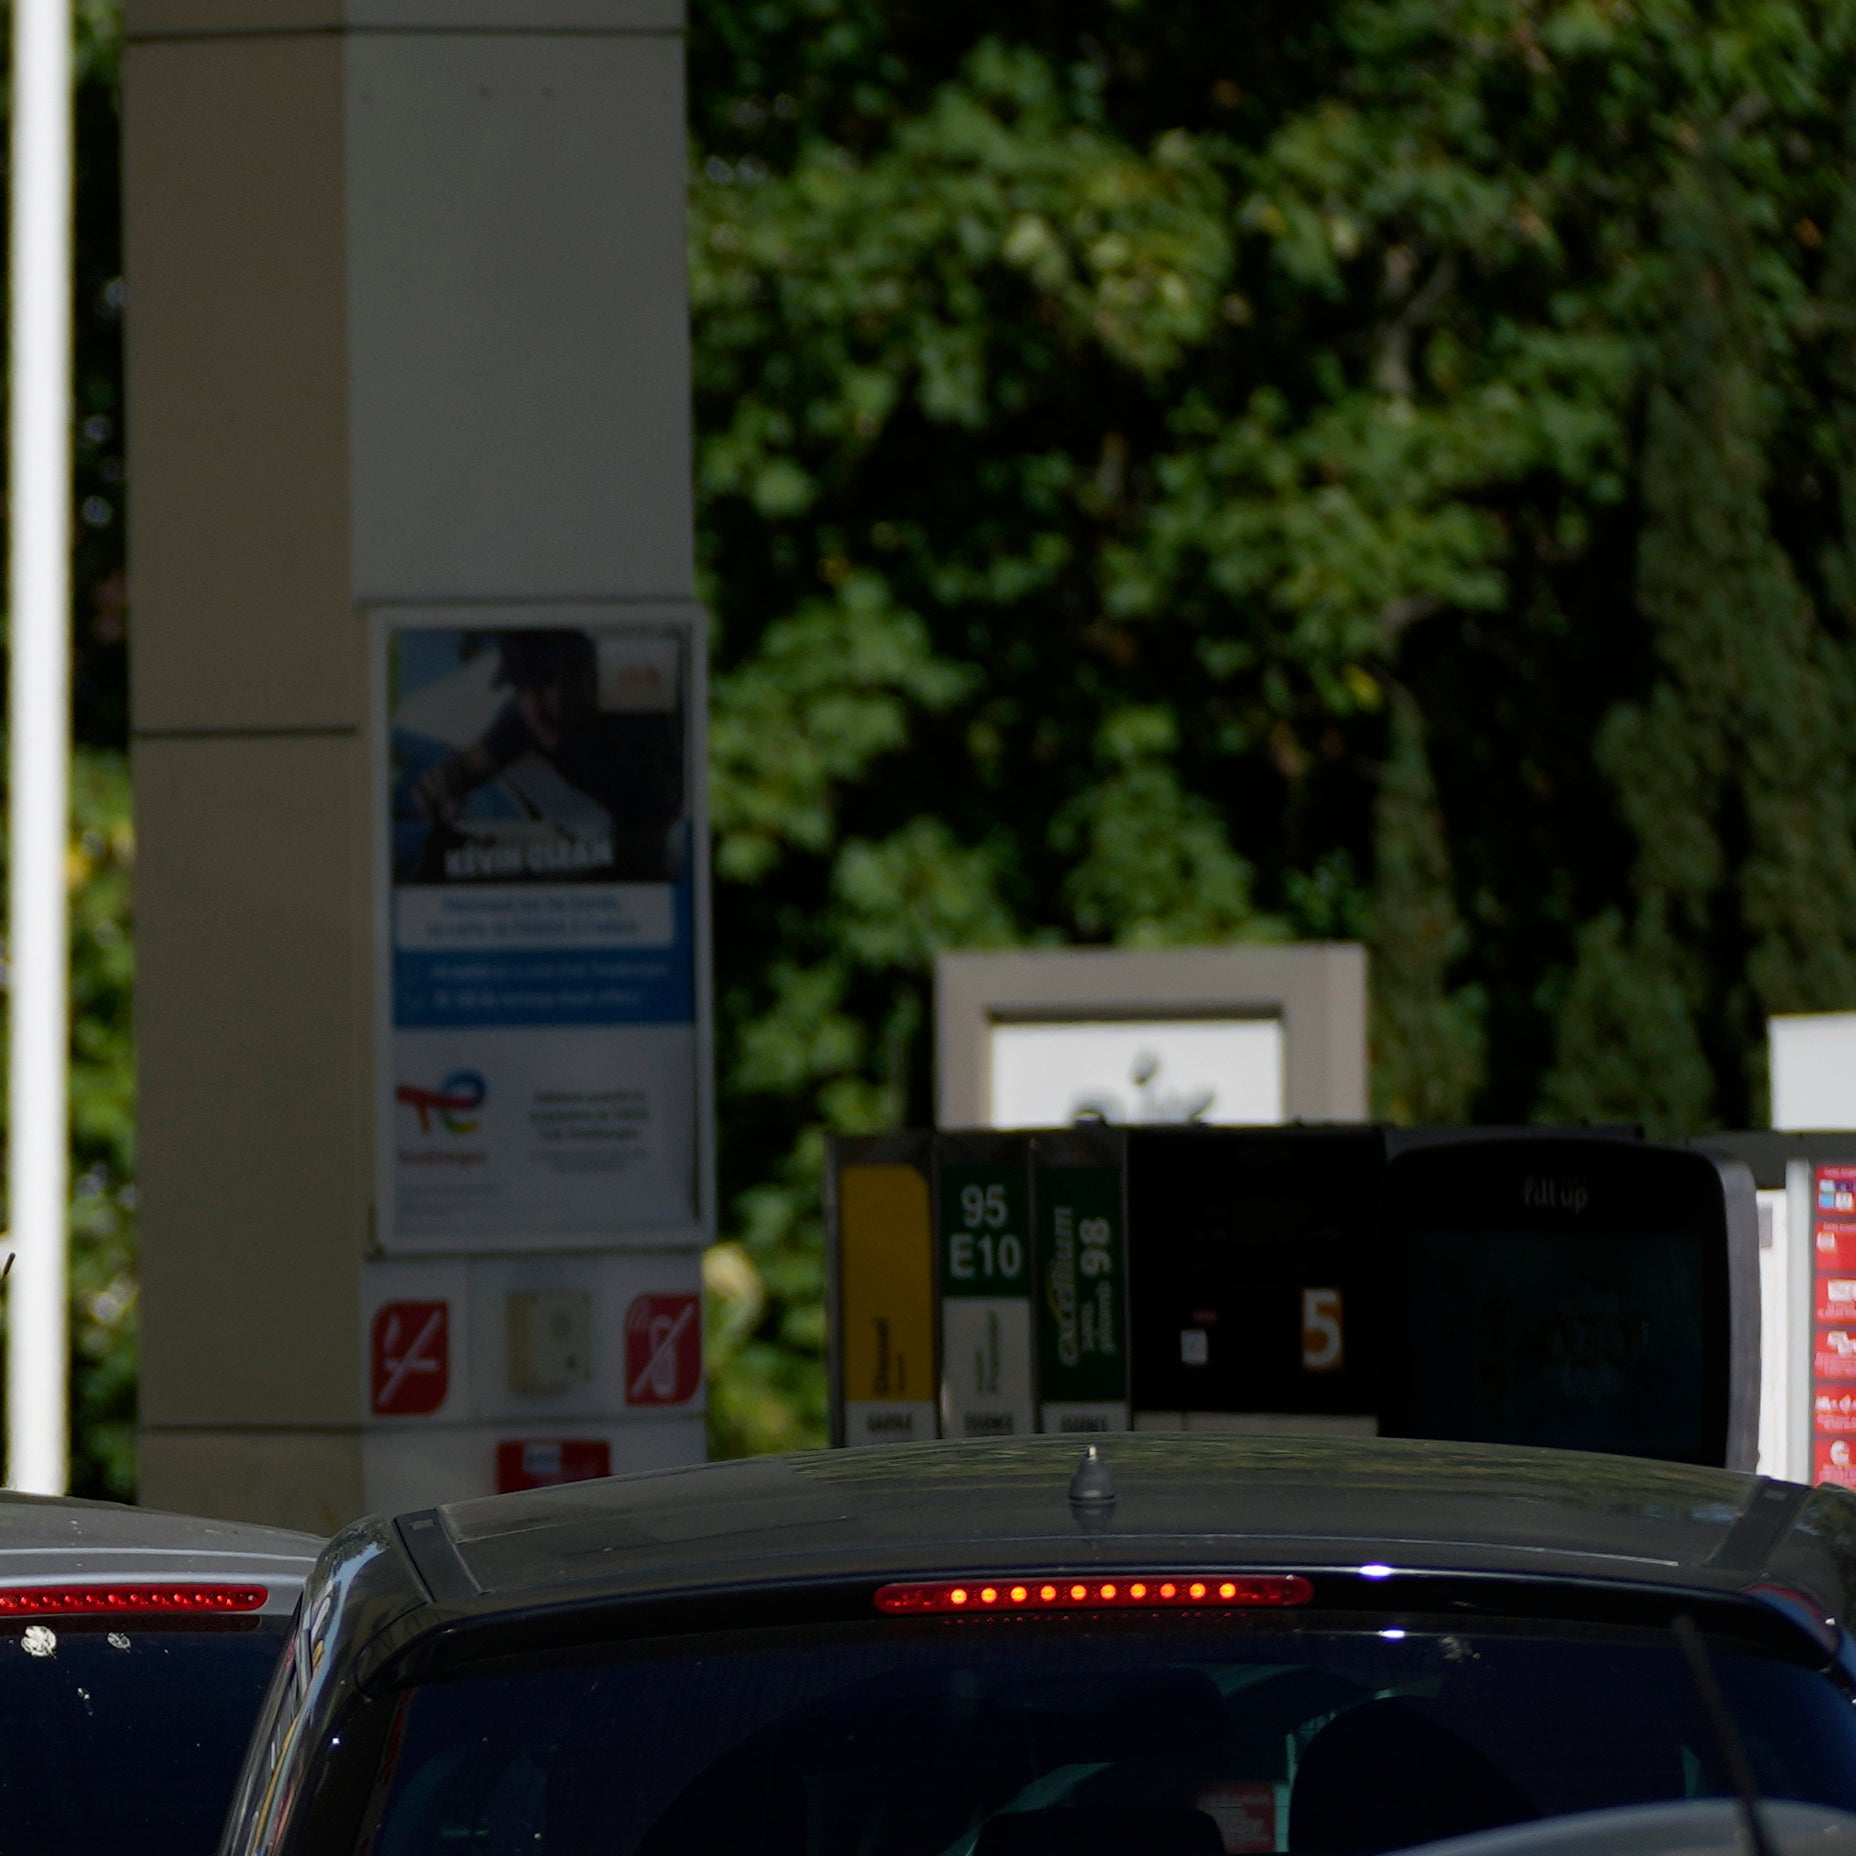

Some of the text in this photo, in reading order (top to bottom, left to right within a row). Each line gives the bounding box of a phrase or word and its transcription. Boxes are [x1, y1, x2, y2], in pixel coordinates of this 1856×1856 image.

[959, 1183, 1009, 1229] 95
[948, 1233, 1023, 1279] E10
[1301, 1286, 1344, 1368] 5
